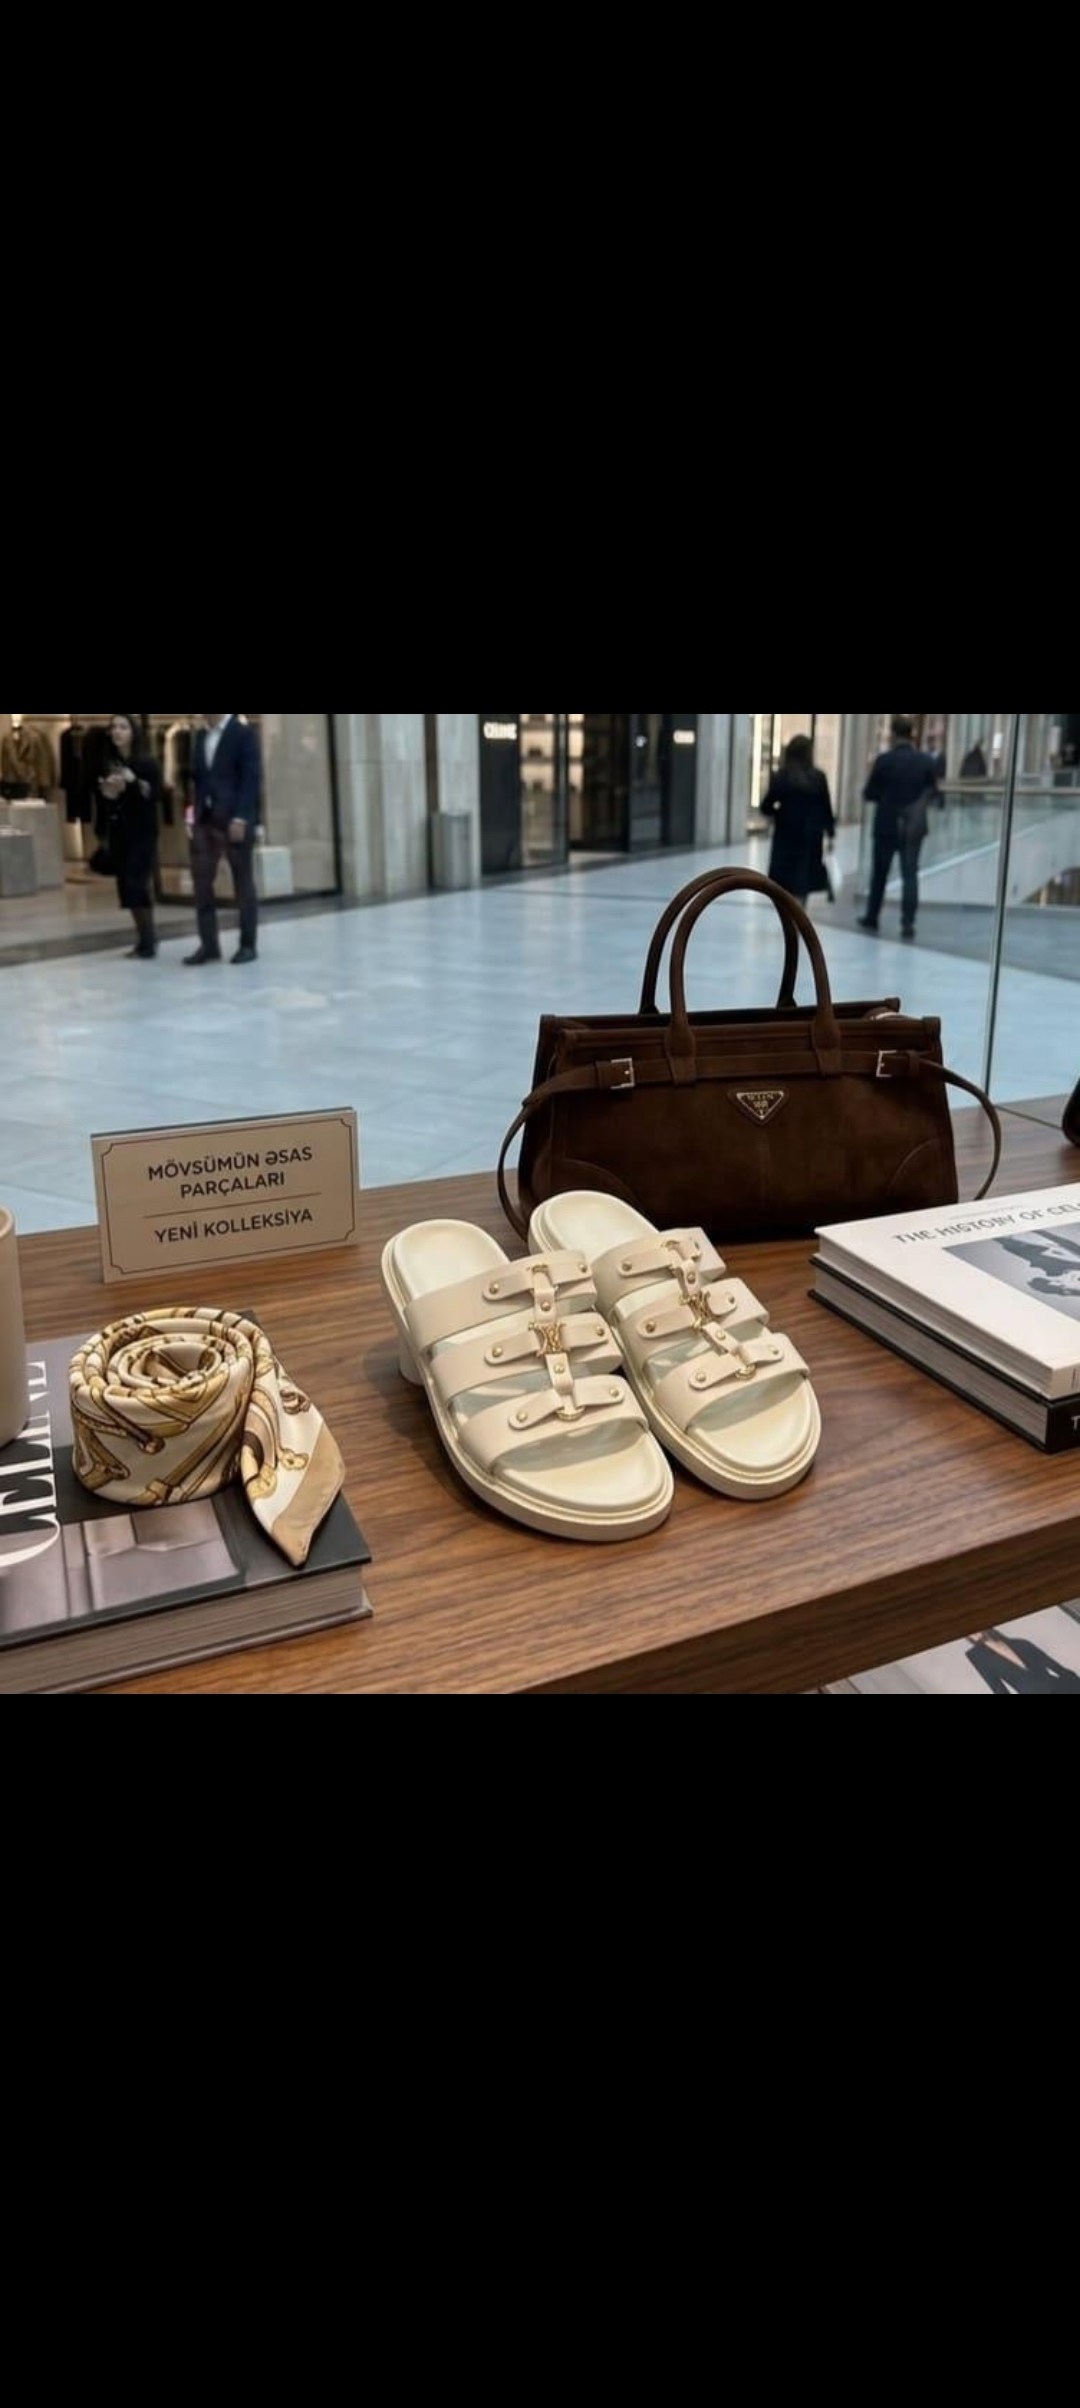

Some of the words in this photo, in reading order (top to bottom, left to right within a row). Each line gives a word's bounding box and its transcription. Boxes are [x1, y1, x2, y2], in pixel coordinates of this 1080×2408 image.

[148, 1152, 260, 1181] MÖVSÜMÜN
[265, 1146, 313, 1166] ƏSAS
[180, 1172, 285, 1199] PARÇALARI
[155, 1224, 198, 1243] YENİ
[203, 1208, 313, 1237] KOLLEKSİYA
[892, 1230, 934, 1244] THE
